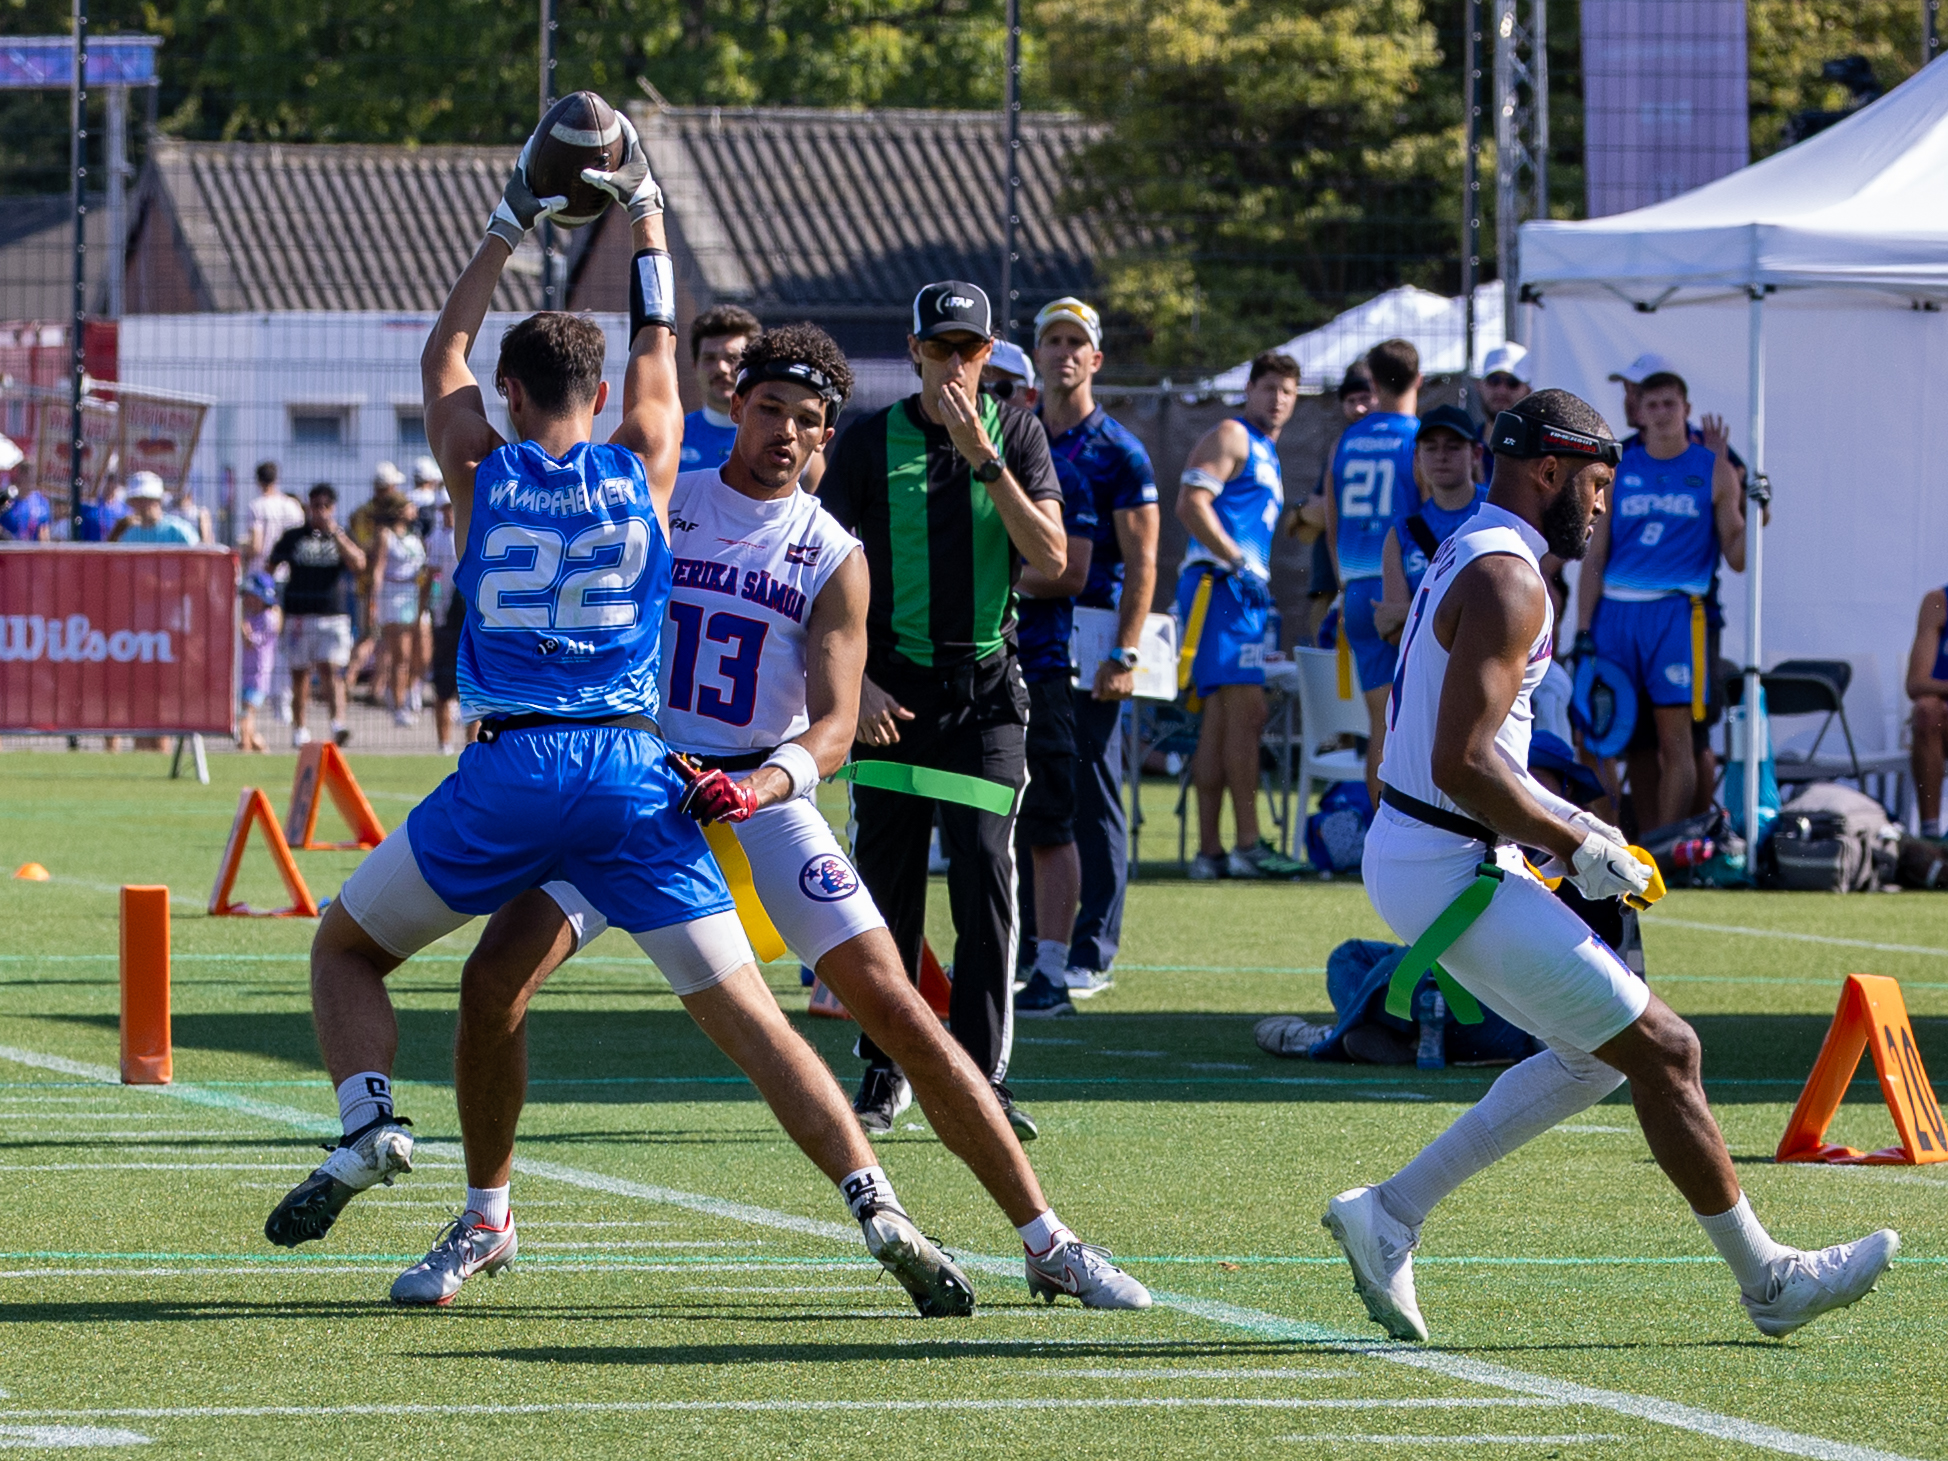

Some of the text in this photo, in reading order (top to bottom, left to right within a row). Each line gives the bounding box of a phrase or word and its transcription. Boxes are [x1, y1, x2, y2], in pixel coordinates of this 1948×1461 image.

[1342, 459, 1396, 517] 21
[475, 516, 651, 632] 22
[0, 612, 178, 663] Wilson
[565, 639, 595, 655] AFI
[668, 600, 769, 727] 13
[1884, 1024, 1948, 1152] 20
